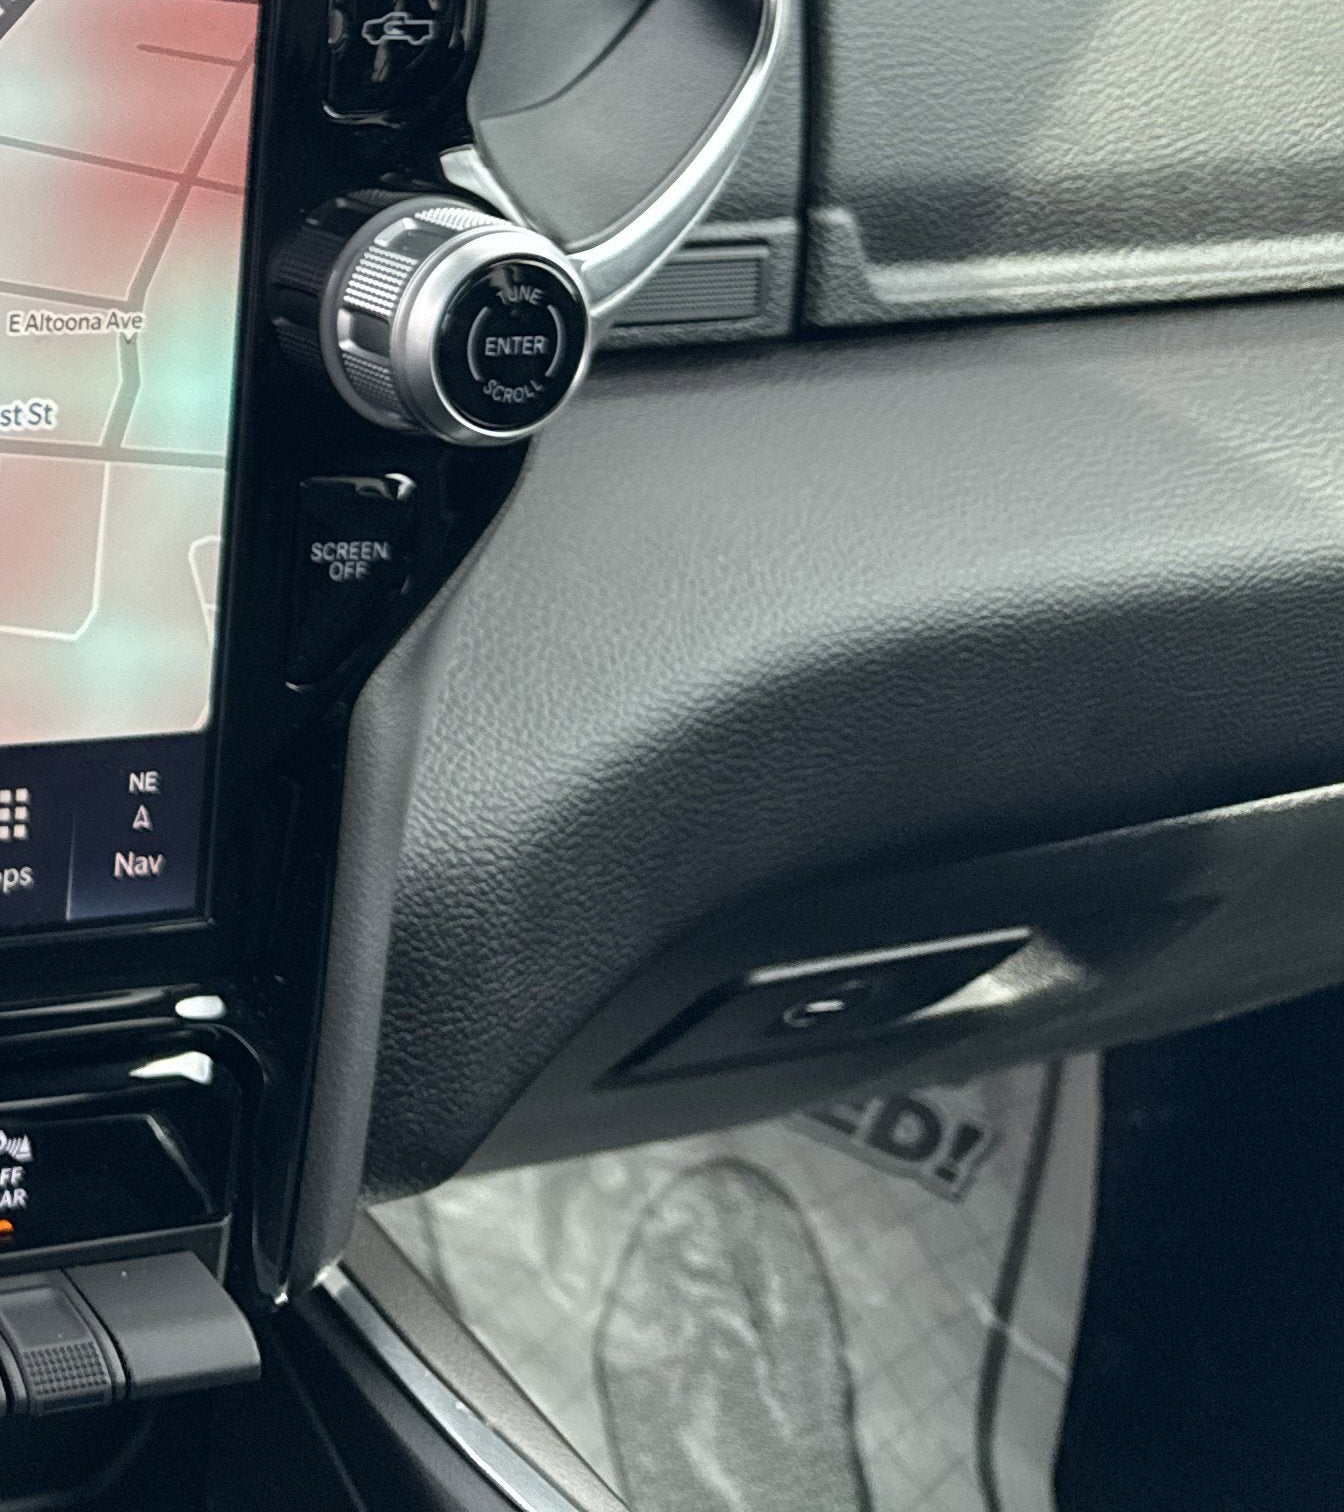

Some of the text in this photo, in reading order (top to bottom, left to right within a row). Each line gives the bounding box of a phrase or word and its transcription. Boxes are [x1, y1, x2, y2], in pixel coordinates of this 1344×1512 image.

[496, 285, 544, 306] TUNE
[9, 312, 143, 333] E Altoona Ave
[485, 335, 545, 356] ENTER
[483, 378, 544, 404] SCROLL
[28, 402, 53, 426] St
[310, 541, 389, 564] SCREEN
[328, 561, 369, 583] OFF
[129, 771, 160, 794] NE
[114, 852, 165, 878] Nav
